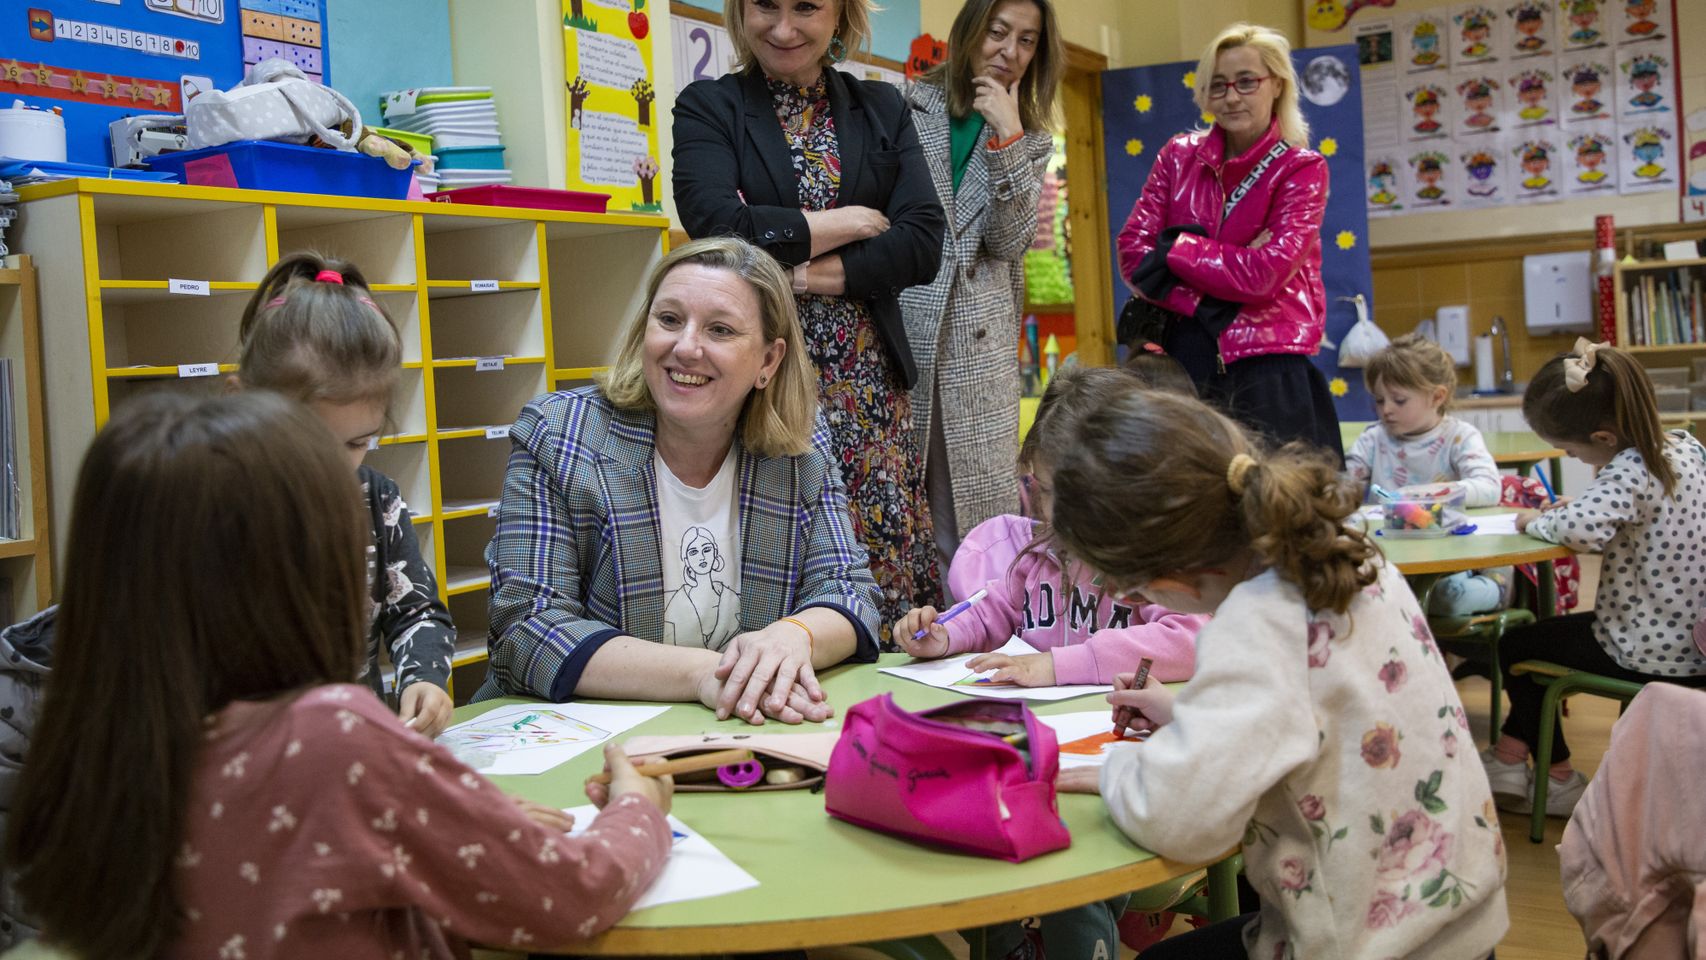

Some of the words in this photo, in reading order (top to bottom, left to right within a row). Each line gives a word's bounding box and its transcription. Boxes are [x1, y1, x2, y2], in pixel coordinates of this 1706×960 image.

[58, 24, 65, 35] 1
[75, 25, 83, 37] 2
[91, 28, 98, 39] 3
[105, 30, 113, 42] 4
[120, 33, 128, 44] 5
[135, 35, 143, 47] 6
[149, 37, 156, 49] 7
[163, 40, 170, 51] 8
[186, 44, 199, 56] 10
[689, 27, 715, 81] 2
[10, 66, 18, 77] 6
[40, 69, 47, 81] 5
[76, 78, 83, 88] 4
[107, 83, 114, 93] 3
[134, 86, 141, 96] 2
[158, 93, 163, 103] 1
[179, 283, 200, 291] PEDRO
[189, 366, 208, 374] LEYRE
